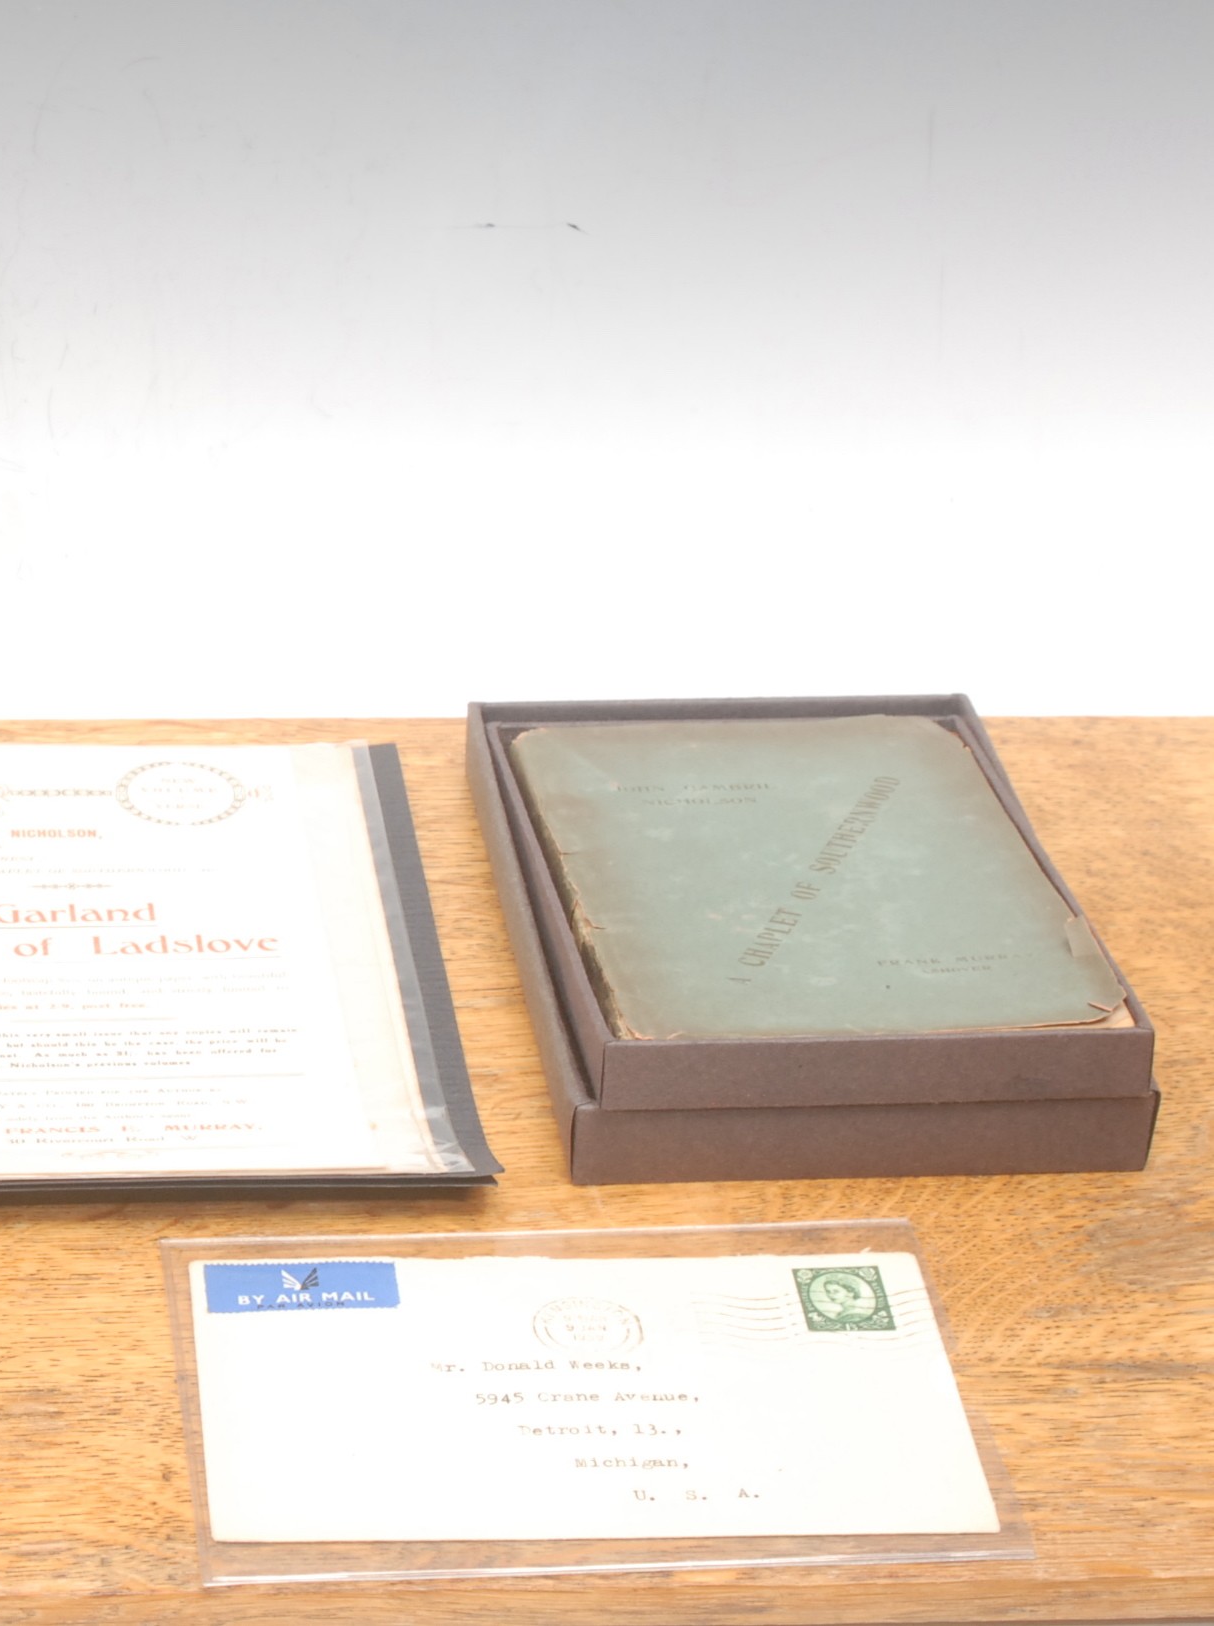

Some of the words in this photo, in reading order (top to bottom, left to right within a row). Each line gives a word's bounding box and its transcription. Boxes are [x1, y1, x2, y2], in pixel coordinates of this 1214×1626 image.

[738, 908, 802, 967] CHAPLET
[790, 881, 821, 900] OF
[809, 776, 900, 875] SOUTHERNWOOD
[13, 937, 52, 957] of
[93, 934, 278, 956] Ladslove
[238, 1294, 265, 1305] BY
[276, 1293, 311, 1303] AIR
[322, 1291, 375, 1302] MAIL
[482, 1359, 555, 1372] Donald
[568, 1359, 642, 1373] Weeks,
[476, 1392, 525, 1406] 5945
[537, 1392, 600, 1403] Crane
[614, 1391, 699, 1404] Avenue,
[517, 1424, 617, 1437] Detroit,
[575, 1457, 689, 1470] Michigan,
[633, 1489, 656, 1502] U.
[685, 1489, 708, 1502] S.
[737, 1487, 760, 1499] A.
